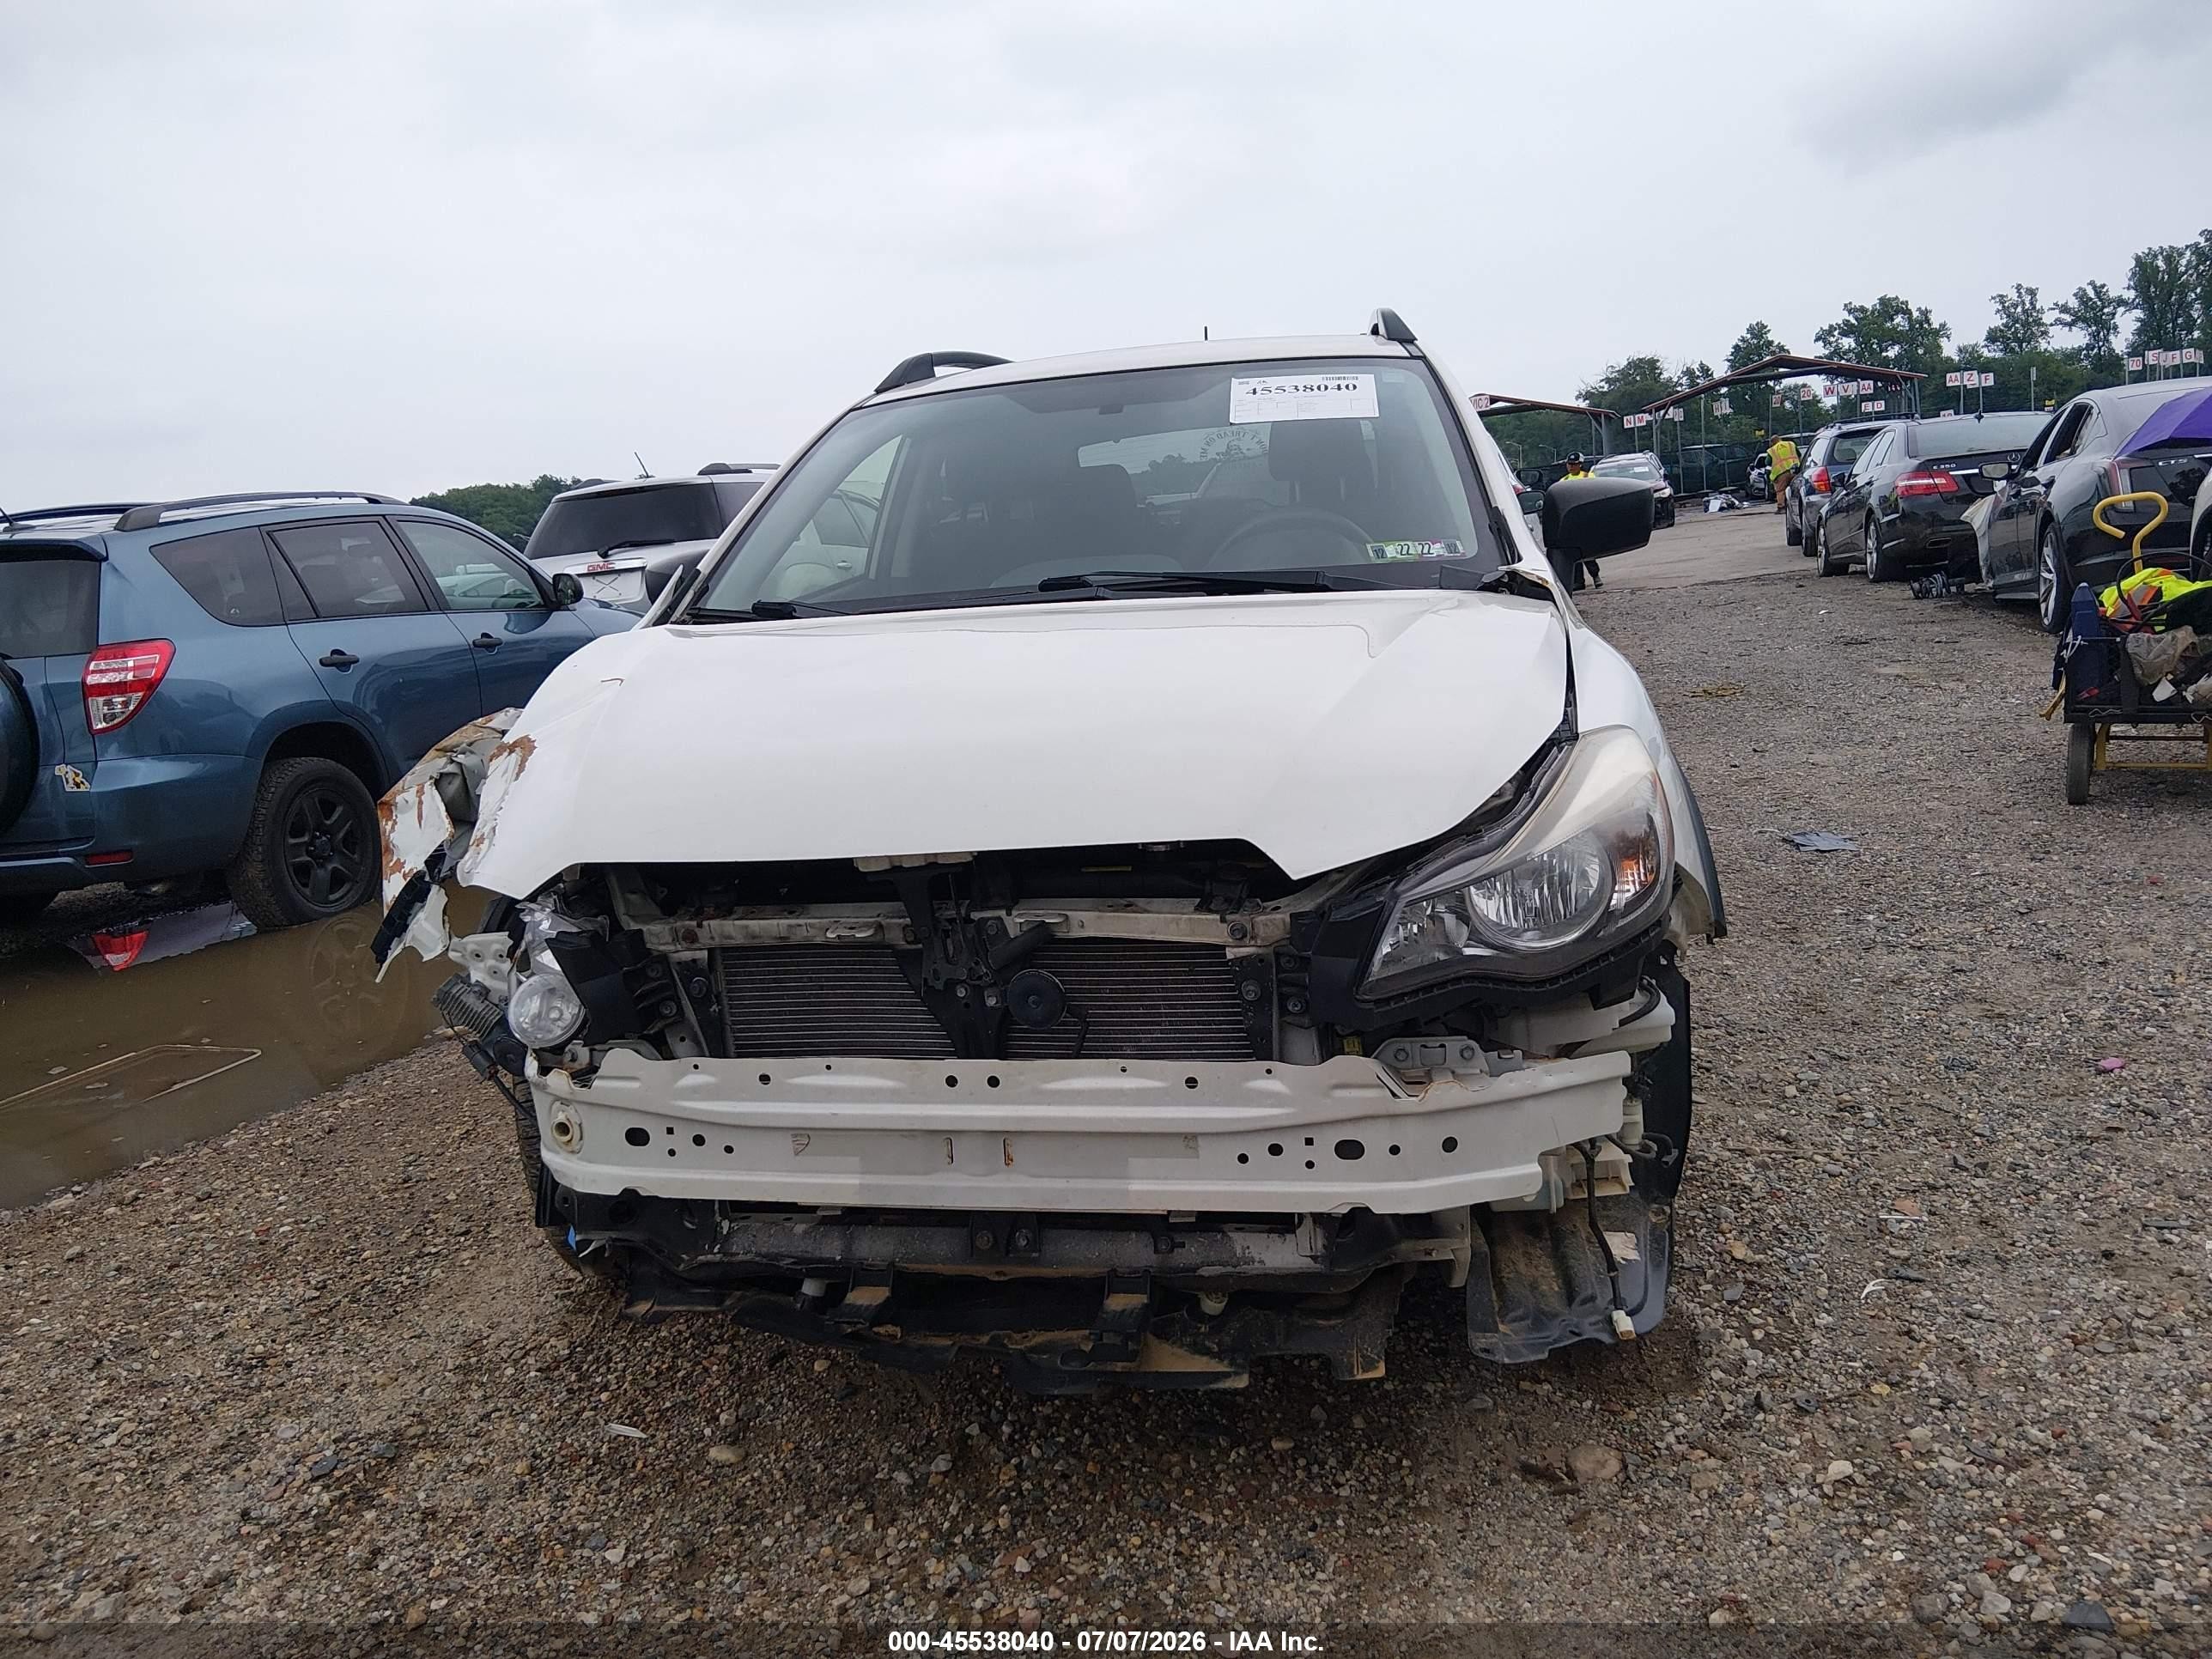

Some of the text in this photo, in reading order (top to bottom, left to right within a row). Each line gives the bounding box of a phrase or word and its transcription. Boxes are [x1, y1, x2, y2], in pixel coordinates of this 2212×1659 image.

[2152, 353, 2158, 362] S
[2172, 354, 2177, 362] F
[2185, 351, 2192, 360] G
[2130, 359, 2141, 368] 70
[1948, 374, 1959, 384] AA
[1967, 374, 1974, 382] Z
[1984, 375, 1990, 384] F
[1245, 383, 1358, 396] 45538040
[1825, 386, 1835, 395] W
[1842, 385, 1850, 393] V
[1861, 383, 1872, 392] AA
[1802, 389, 1811, 398] 20
[1484, 398, 1489, 408] 2
[1626, 417, 1632, 426] N
[1638, 416, 1644, 424] M
[1374, 544, 1413, 559] 12 22
[1418, 542, 1436, 555] 22
[587, 562, 616, 572] GMC
